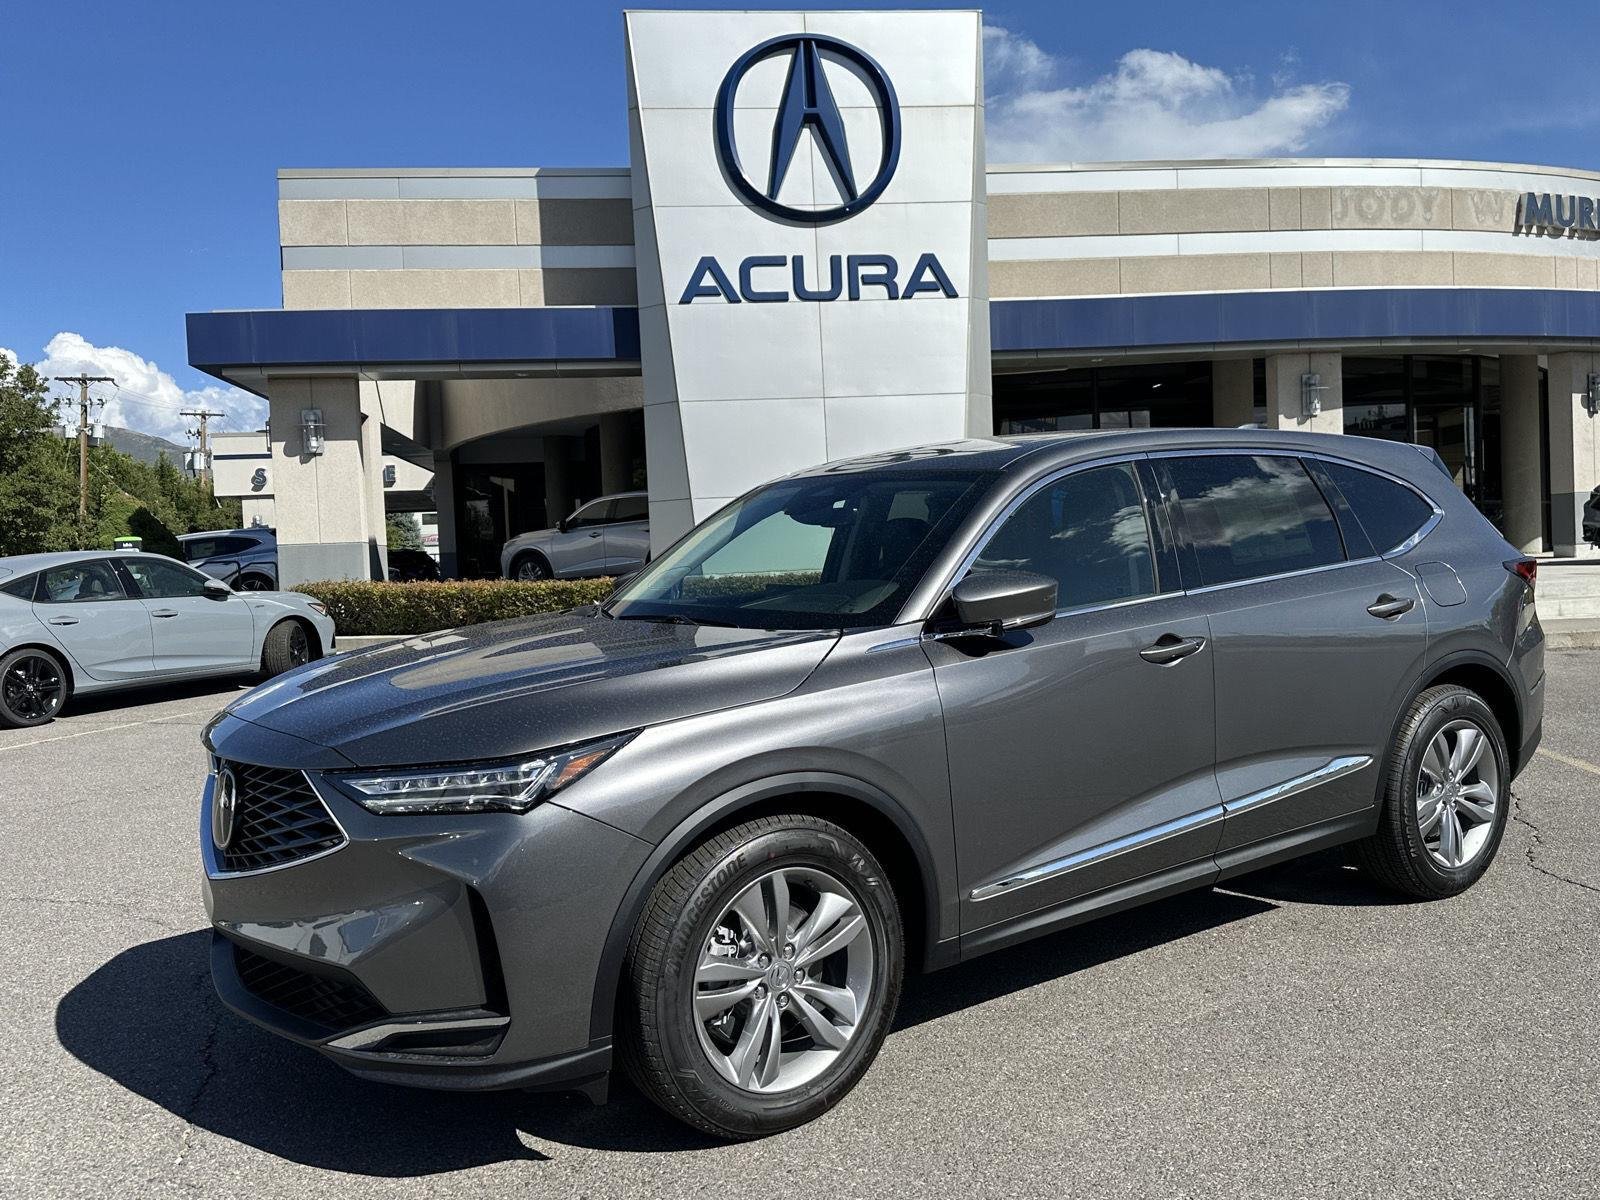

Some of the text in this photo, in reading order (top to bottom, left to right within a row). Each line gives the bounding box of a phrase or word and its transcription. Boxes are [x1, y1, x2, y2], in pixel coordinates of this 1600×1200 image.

[1332, 188, 1440, 225] JODY
[1522, 191, 1600, 232] MUR
[678, 252, 959, 305] ACURA
